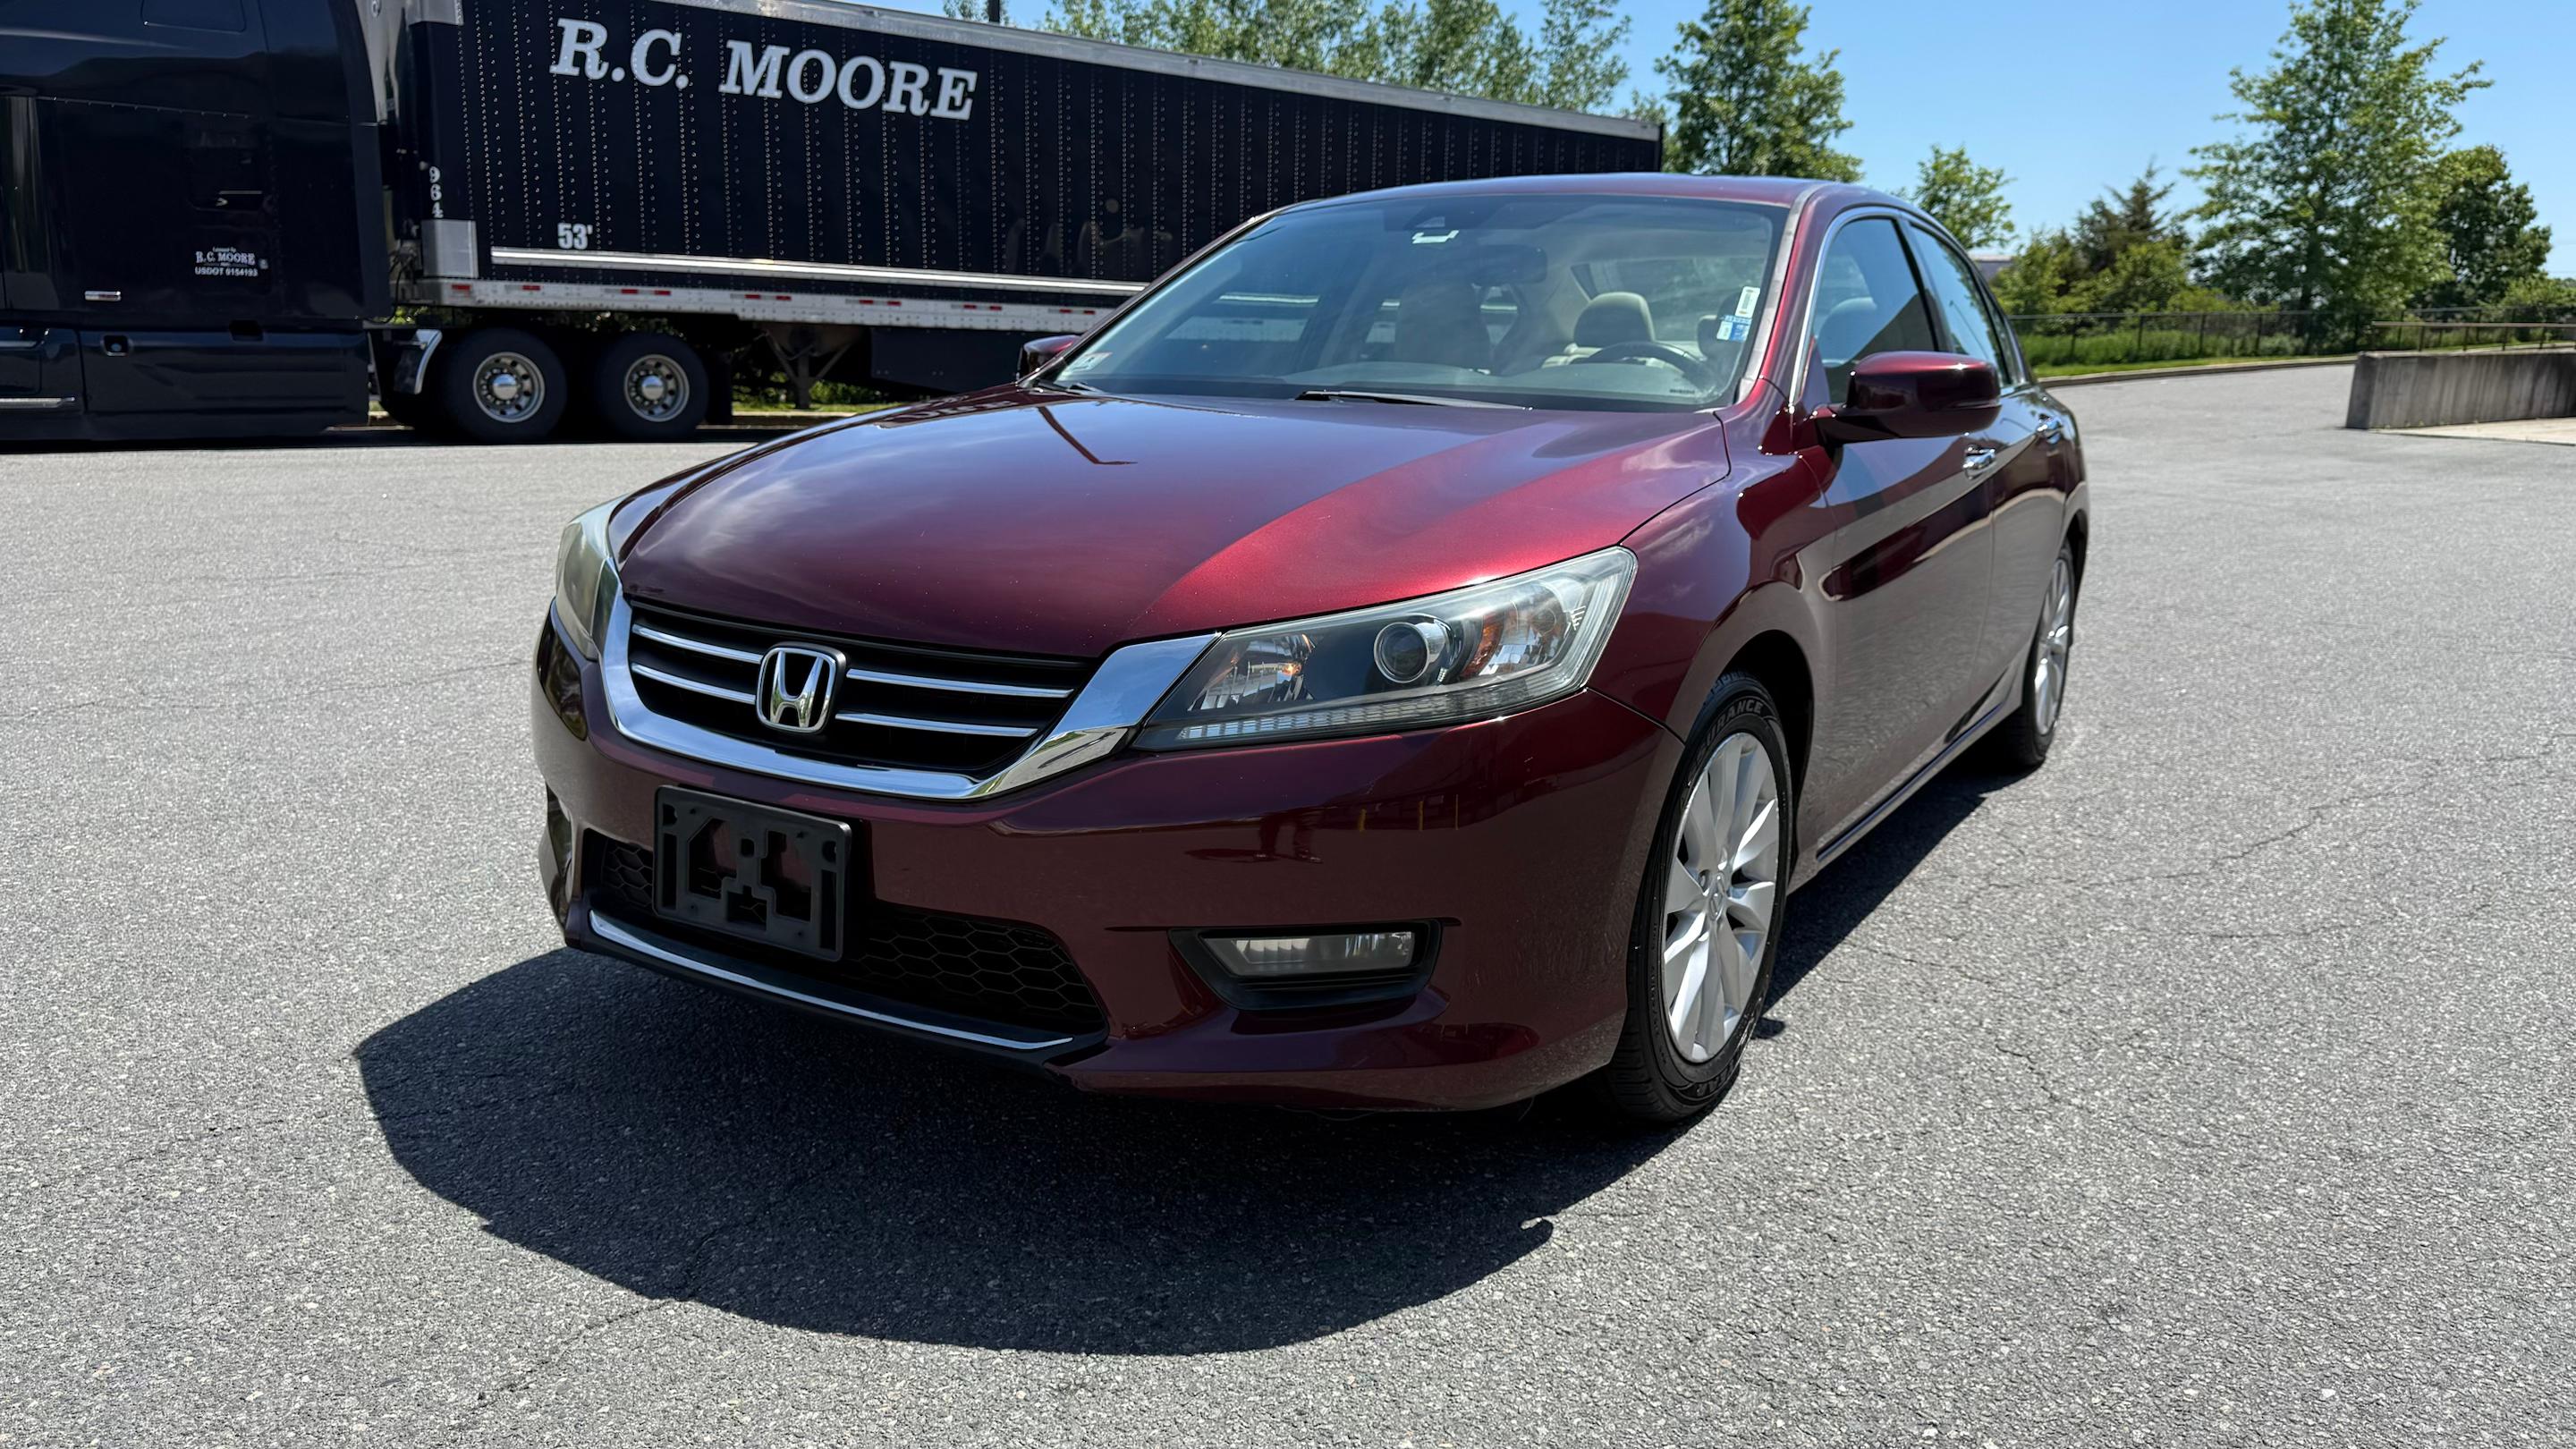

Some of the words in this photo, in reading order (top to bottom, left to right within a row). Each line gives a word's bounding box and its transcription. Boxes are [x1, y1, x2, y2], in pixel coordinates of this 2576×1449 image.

[549, 18, 689, 89] R.C.
[718, 39, 978, 120] MOORE
[217, 252, 256, 266] MOORE
